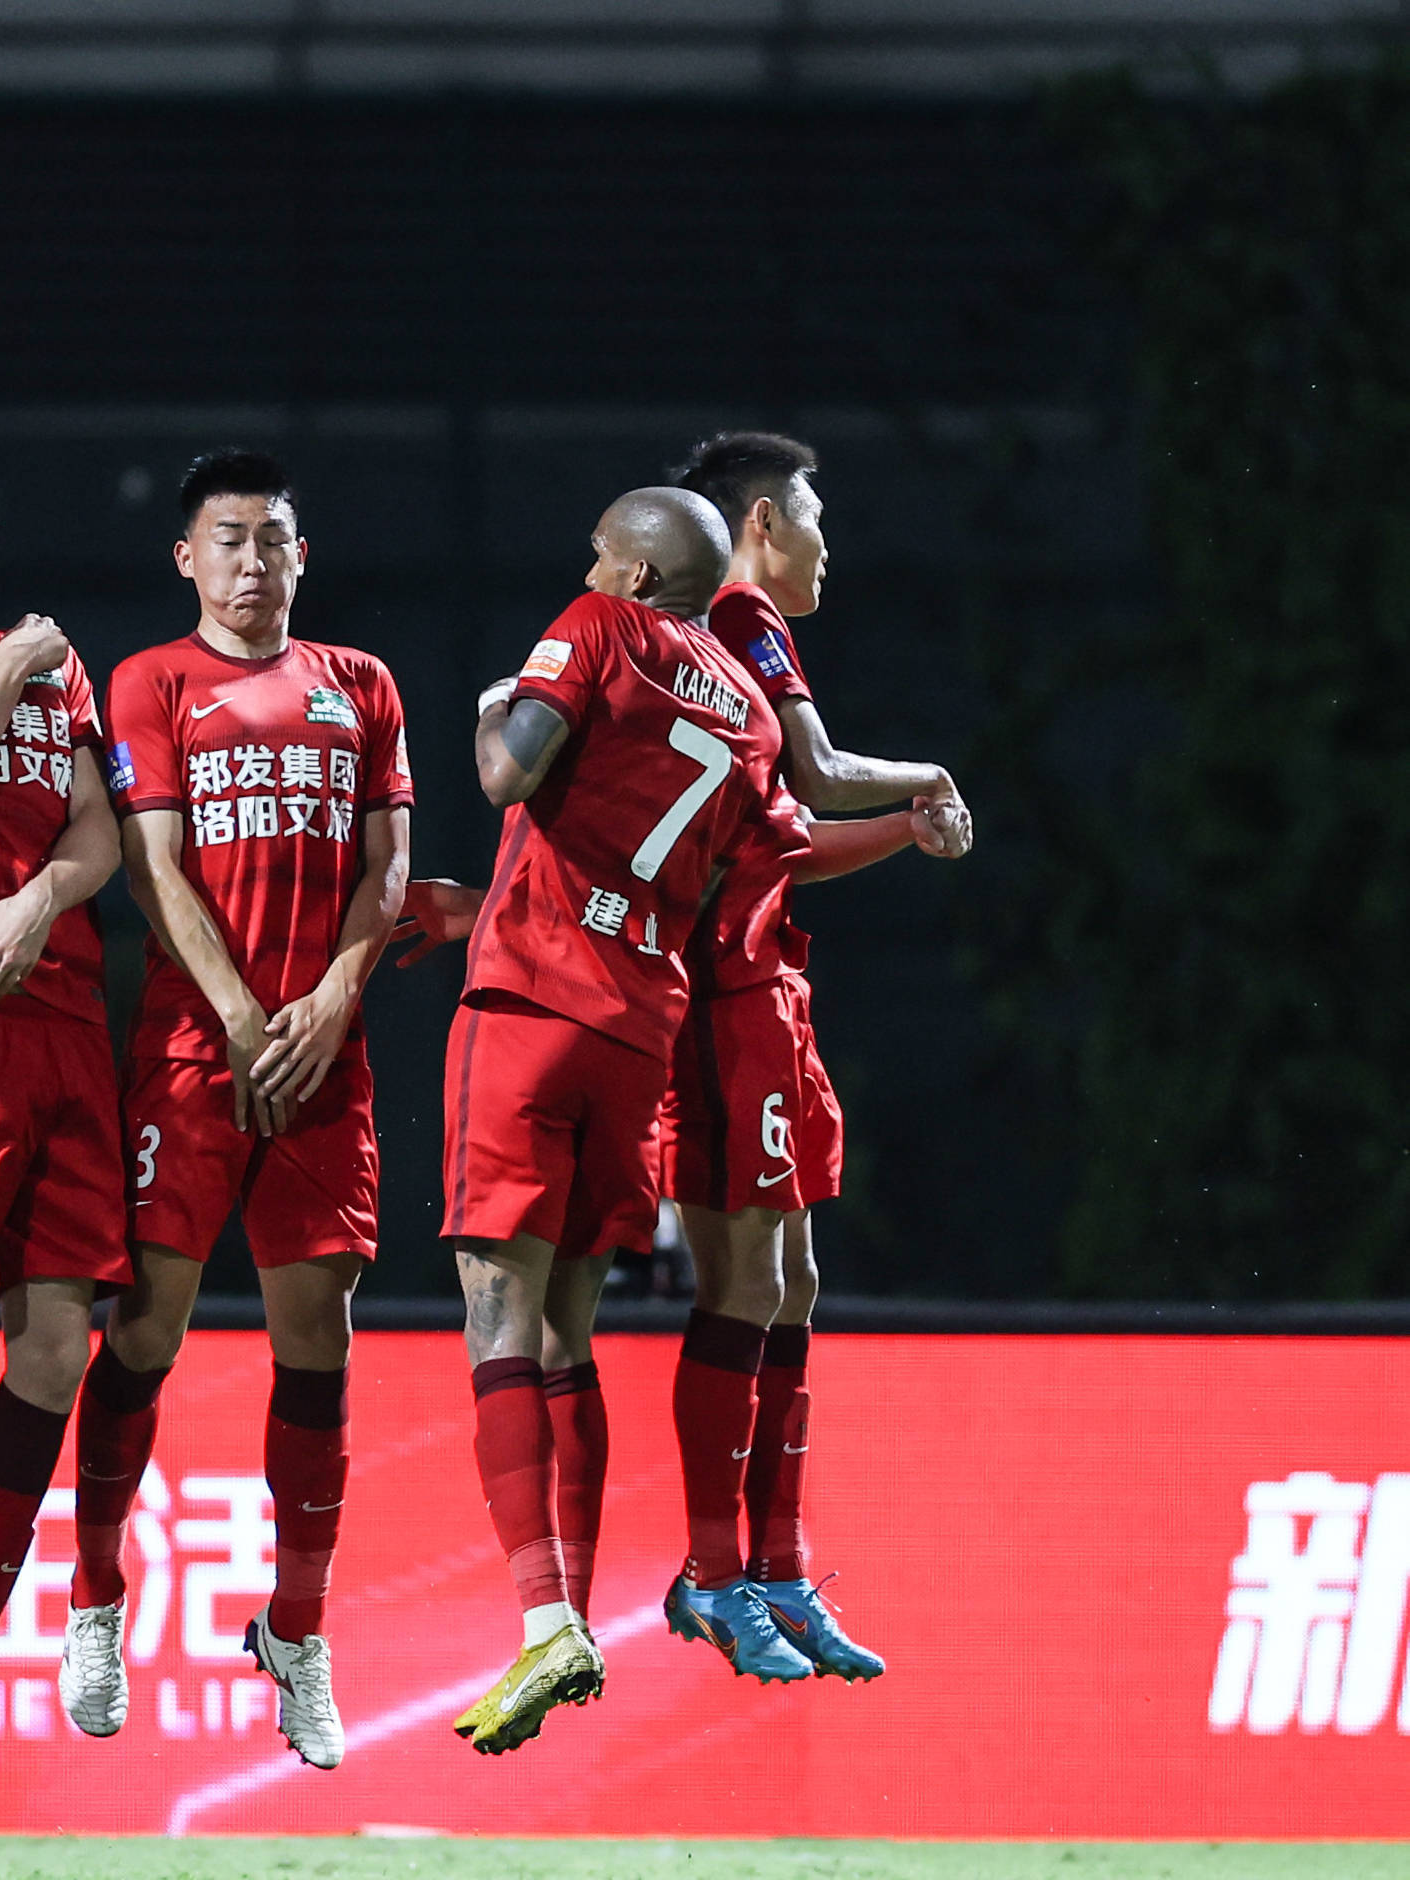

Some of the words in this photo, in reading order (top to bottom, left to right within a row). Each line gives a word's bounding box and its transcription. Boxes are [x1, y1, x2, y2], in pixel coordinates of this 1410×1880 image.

[0, 702, 72, 749] 集团
[673, 662, 750, 730] KARANGA
[188, 744, 360, 799] 郑发集团
[630, 716, 732, 883] 7
[192, 793, 354, 848] 洛阳文旅
[761, 1092, 787, 1158] 6
[158, 1678, 282, 1738] LIF
